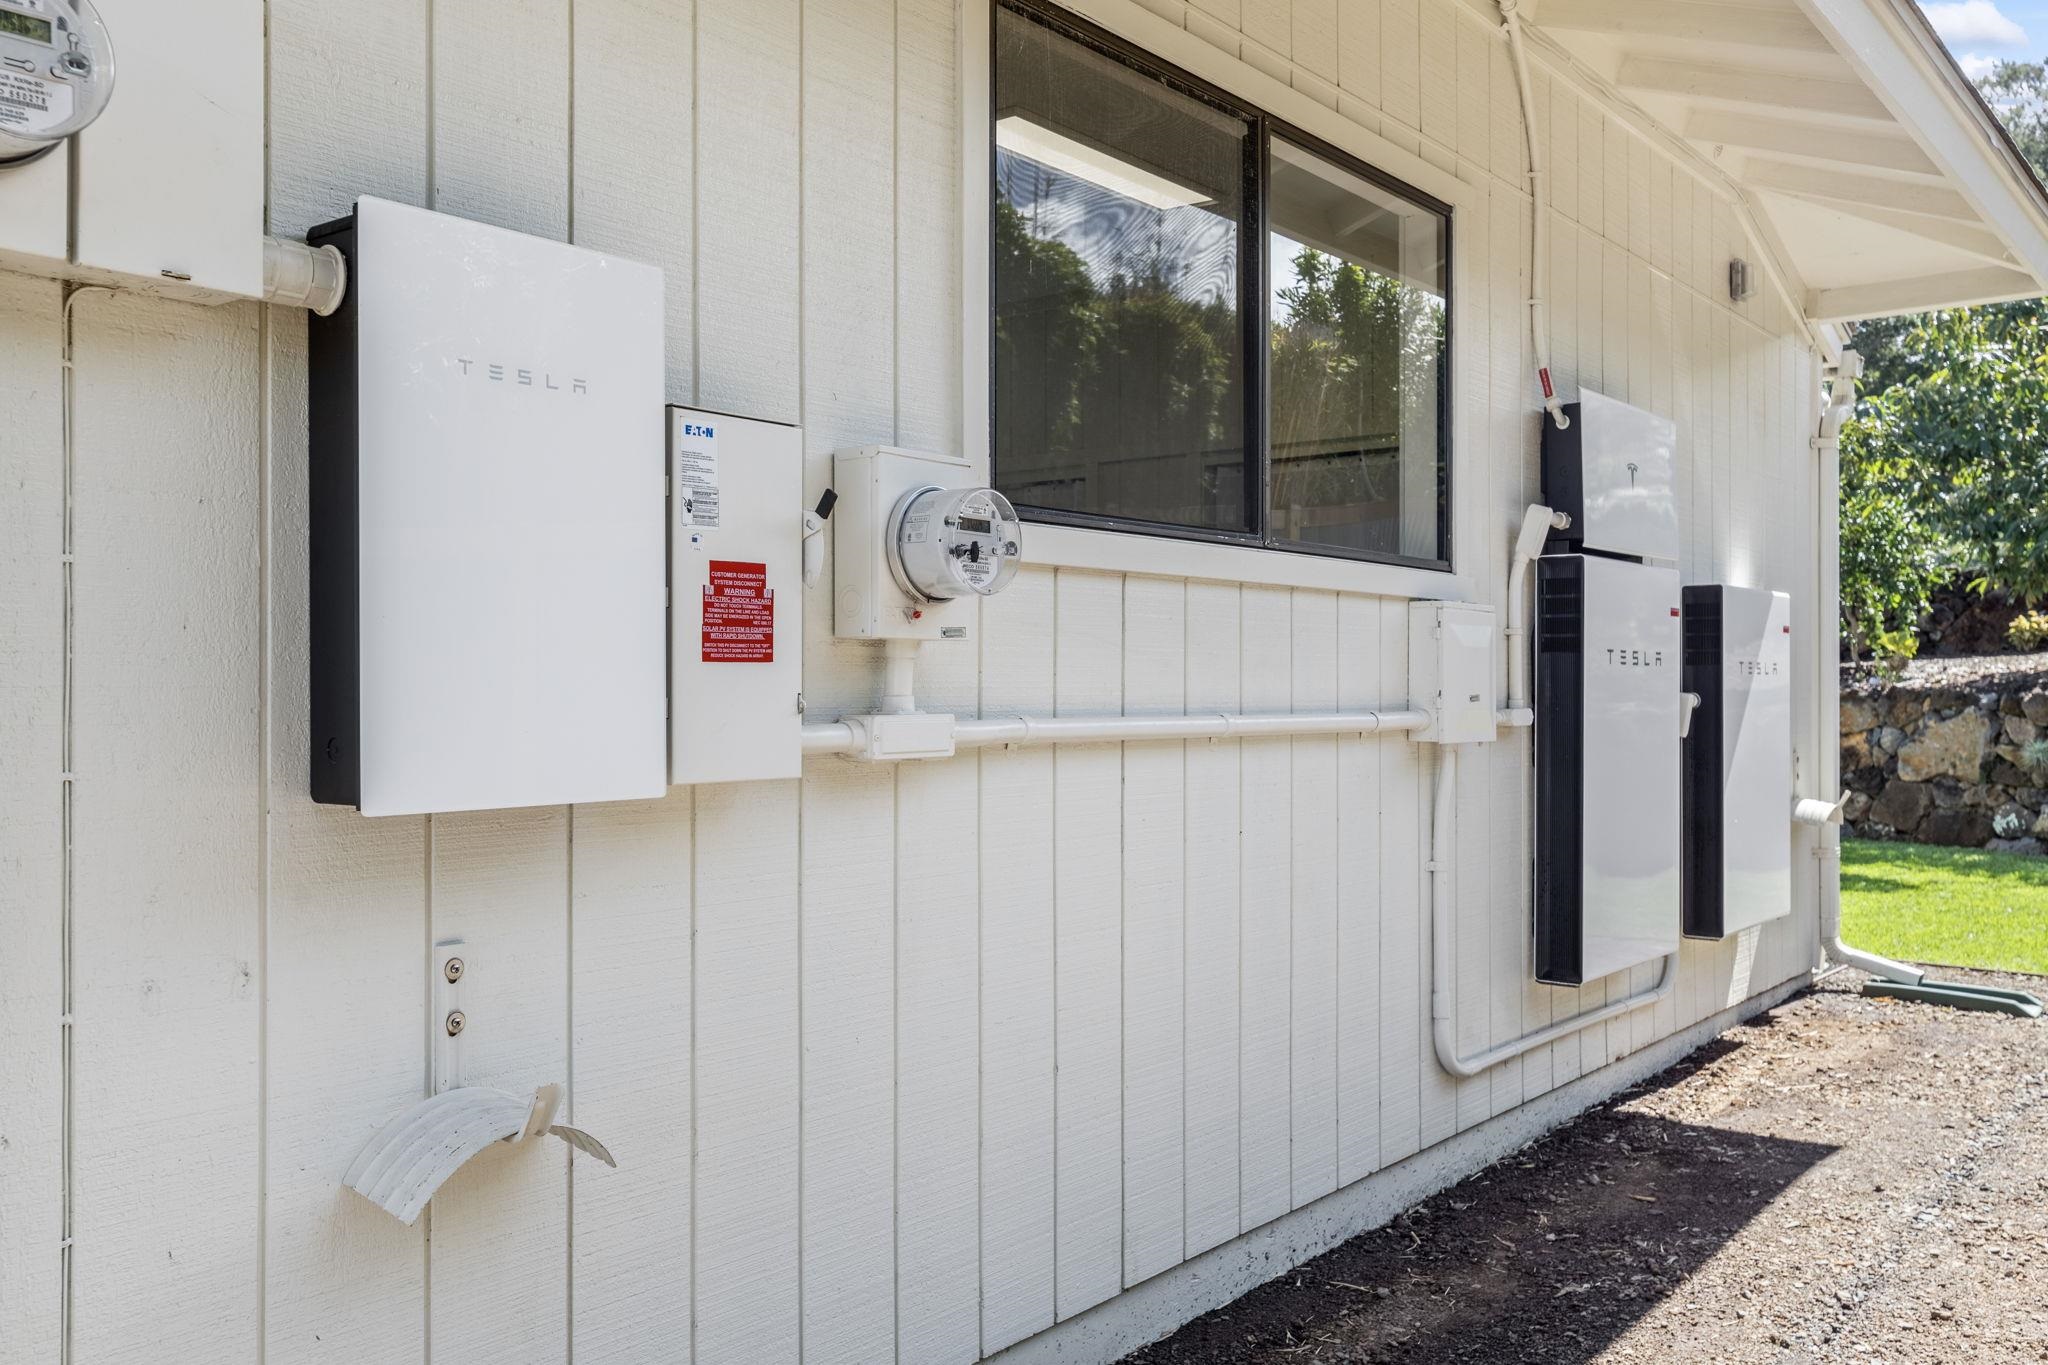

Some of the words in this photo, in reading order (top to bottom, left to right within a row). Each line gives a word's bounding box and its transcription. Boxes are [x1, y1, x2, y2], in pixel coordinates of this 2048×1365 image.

[457, 358, 587, 395] TESLA
[724, 588, 756, 596] WARNING
[1607, 649, 1662, 666] TESLA
[1739, 662, 1778, 676] TESLA
